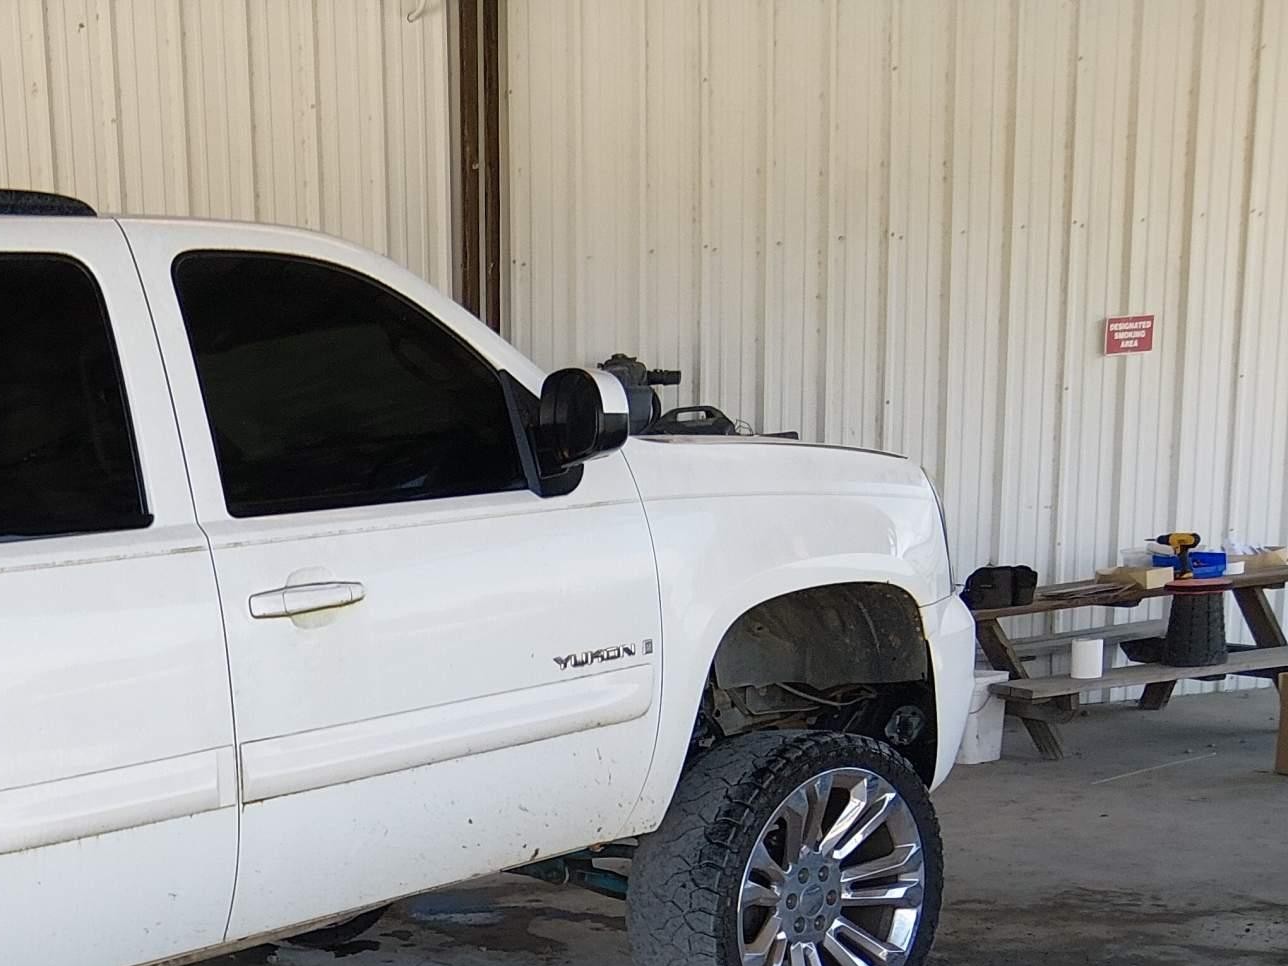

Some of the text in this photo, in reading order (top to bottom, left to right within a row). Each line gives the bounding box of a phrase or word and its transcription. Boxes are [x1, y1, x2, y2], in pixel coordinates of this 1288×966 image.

[1109, 320, 1152, 331] DESIGNATED
[1114, 330, 1145, 340] SMOKING
[1120, 339, 1138, 348] AREA
[553, 643, 636, 670] YUKON
